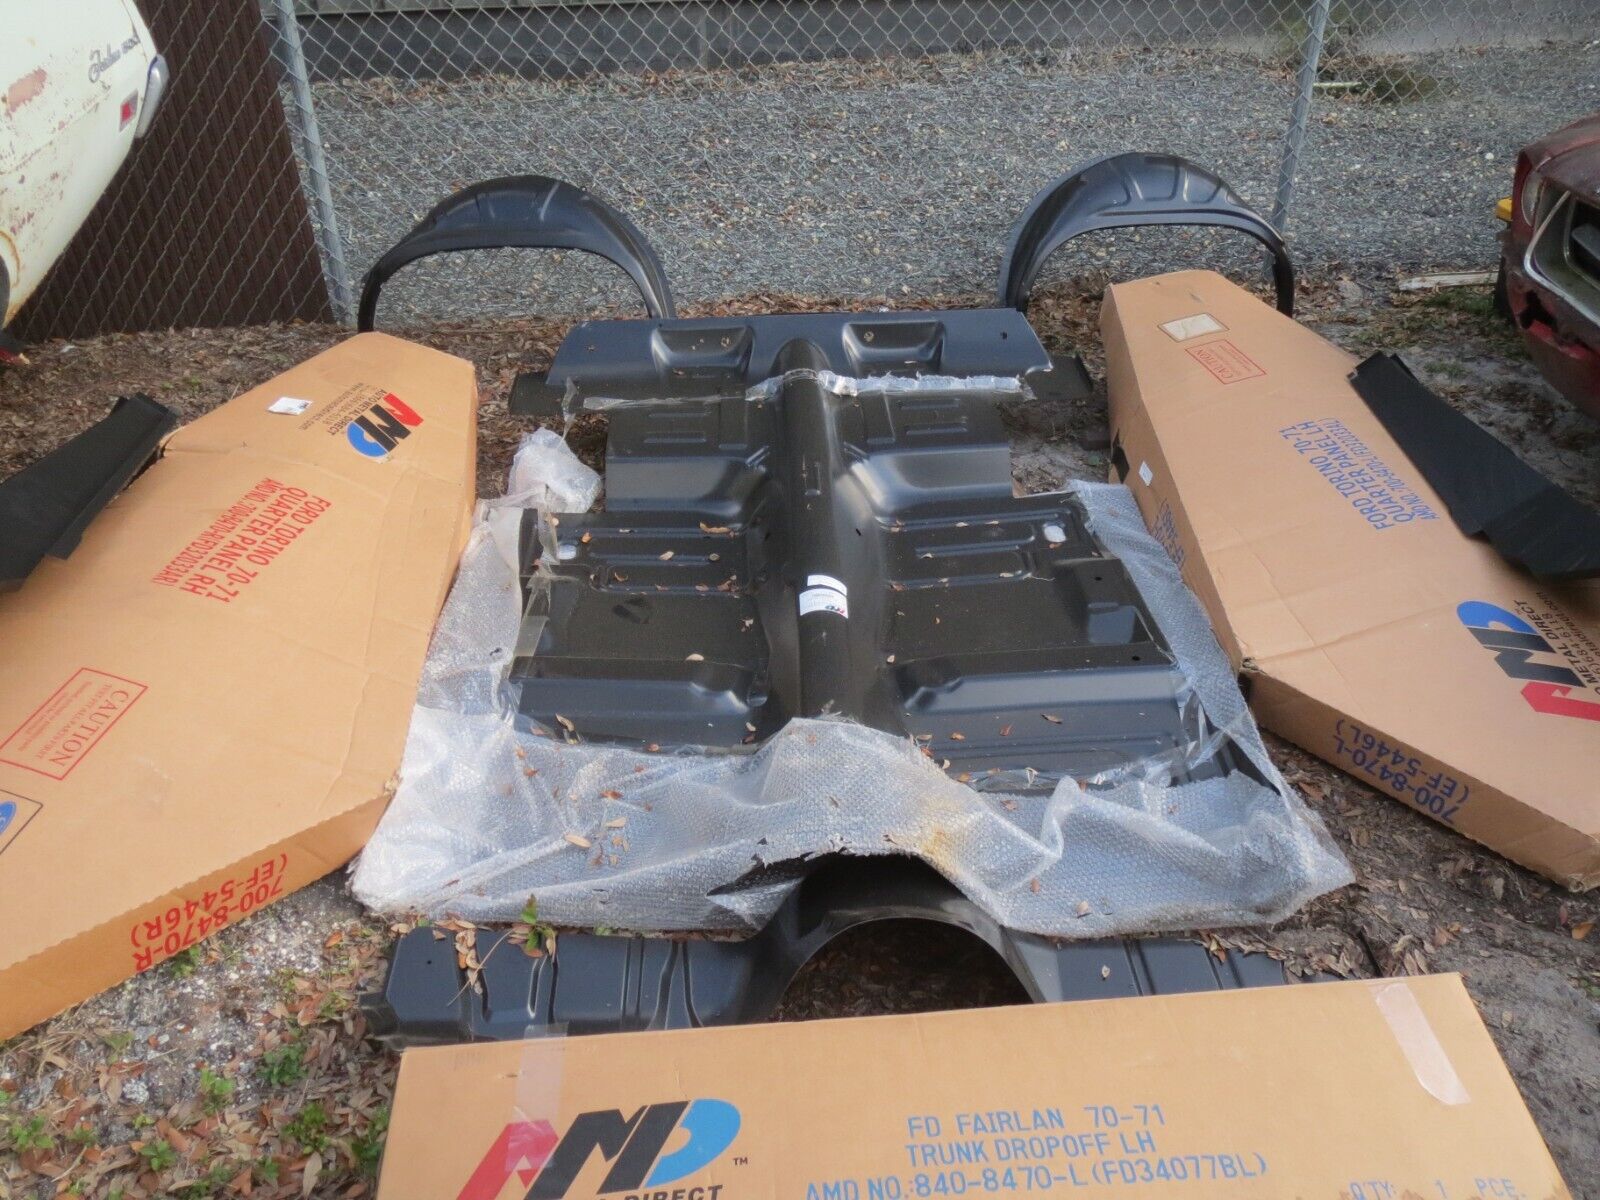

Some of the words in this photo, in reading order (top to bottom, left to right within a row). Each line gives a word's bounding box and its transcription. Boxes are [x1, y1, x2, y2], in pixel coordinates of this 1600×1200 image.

[1279, 425, 1319, 455] 70-71
[1297, 420, 1323, 435] LH
[1314, 435, 1359, 469] PANEL
[254, 477, 284, 494] AMD
[1309, 455, 1362, 499] TORINO
[1349, 467, 1416, 523] QUARTER
[241, 486, 308, 536] QUARTER
[290, 495, 332, 525] FORD
[1352, 497, 1395, 531] FORD
[200, 534, 257, 572] PANEL
[246, 522, 305, 566] TORINO
[179, 573, 216, 595] RH
[205, 566, 259, 603] 70-71
[1513, 600, 1560, 640] DIRECT
[1558, 643, 1598, 684] METAL
[49, 690, 129, 767] CAUTION
[1333, 734, 1460, 824] 700-8470-L
[1336, 719, 1469, 804] (EF-5446L)
[130, 853, 288, 947] (EF-5446R)
[132, 874, 284, 972] 700-8470-R
[907, 1115, 942, 1139] FD
[956, 1108, 1065, 1135] FAIRLAN
[1084, 1104, 1166, 1128] 70-71
[906, 1140, 989, 1168] TRUNK
[994, 1132, 1111, 1161] DROPOFF
[1119, 1130, 1157, 1155] LH
[624, 1185, 723, 1200] ECT
[806, 1179, 859, 1200] AMD
[1434, 1179, 1448, 1200] 1
